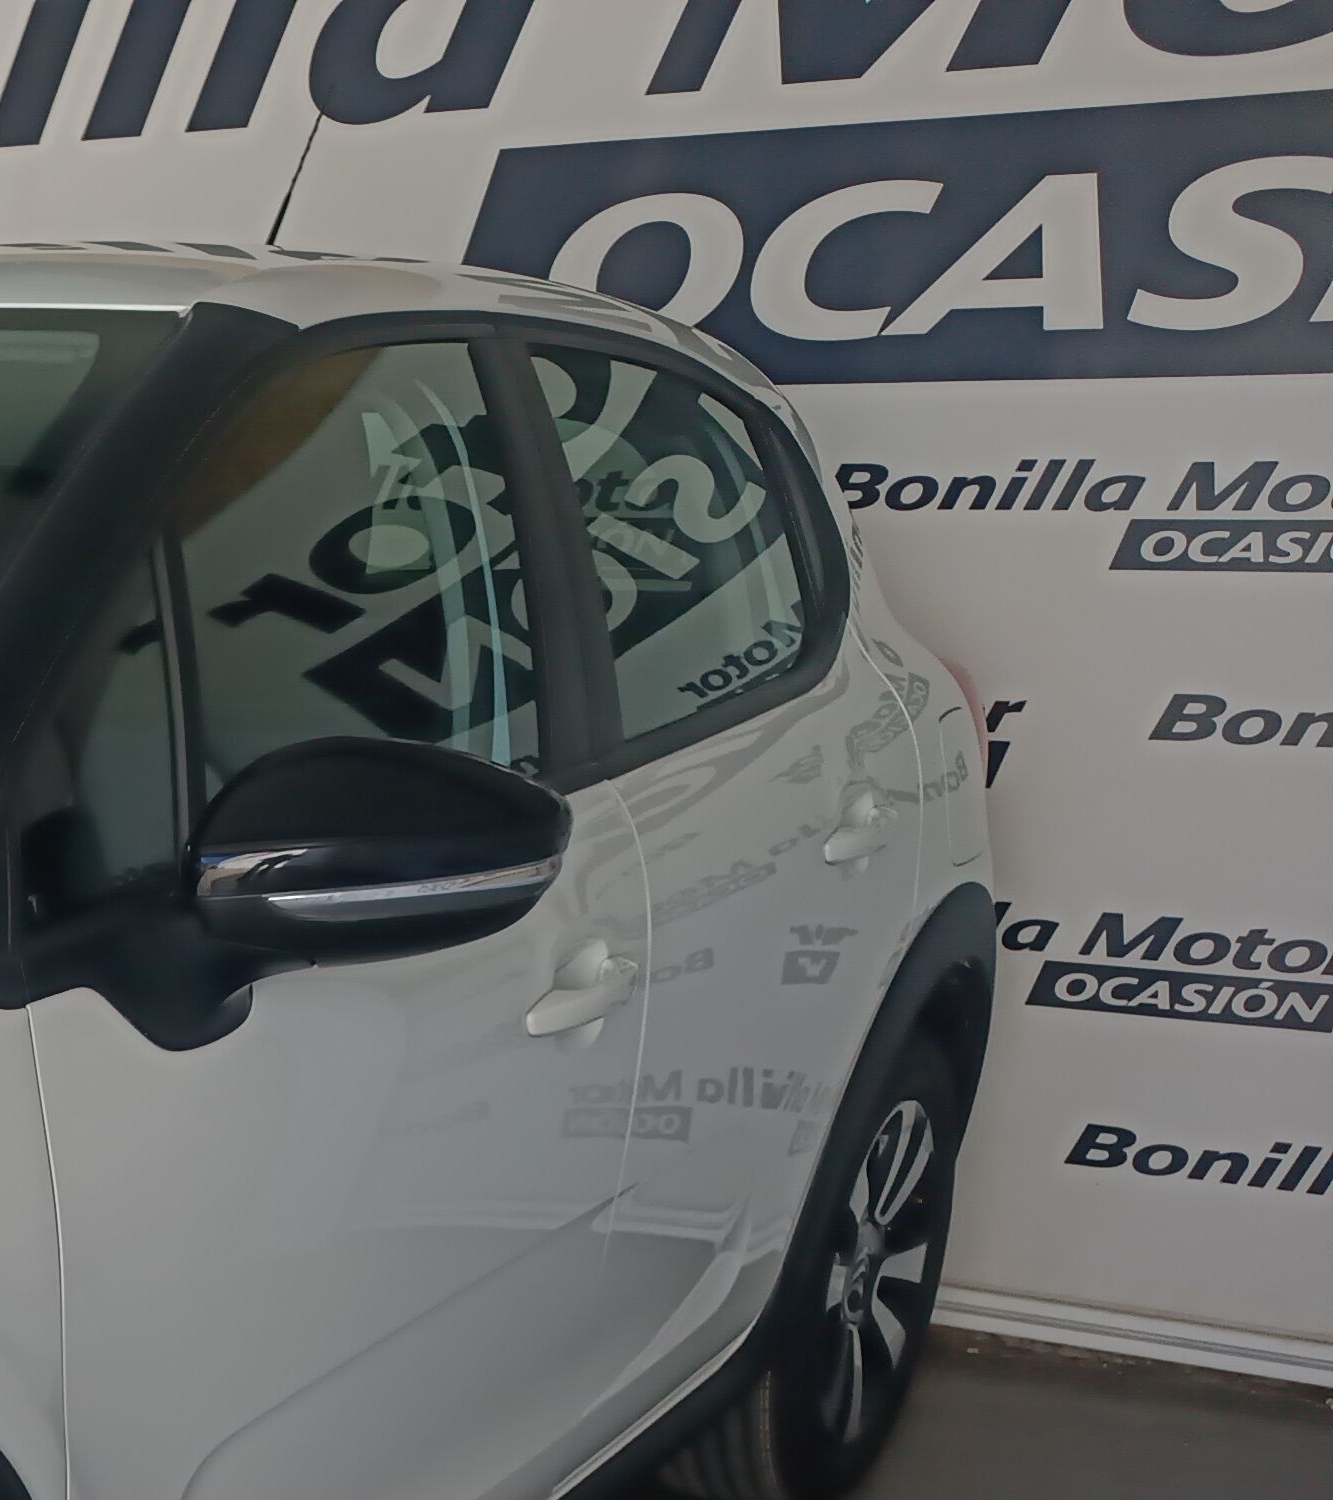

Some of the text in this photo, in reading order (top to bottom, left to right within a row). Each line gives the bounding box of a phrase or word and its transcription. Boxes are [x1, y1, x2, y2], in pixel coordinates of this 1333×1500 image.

[549, 155, 1333, 342] OCAS
[835, 459, 1333, 512] Bonilla Mo
[1140, 530, 1333, 564] OCASI
[1054, 973, 1331, 1023] OCASIÓN
